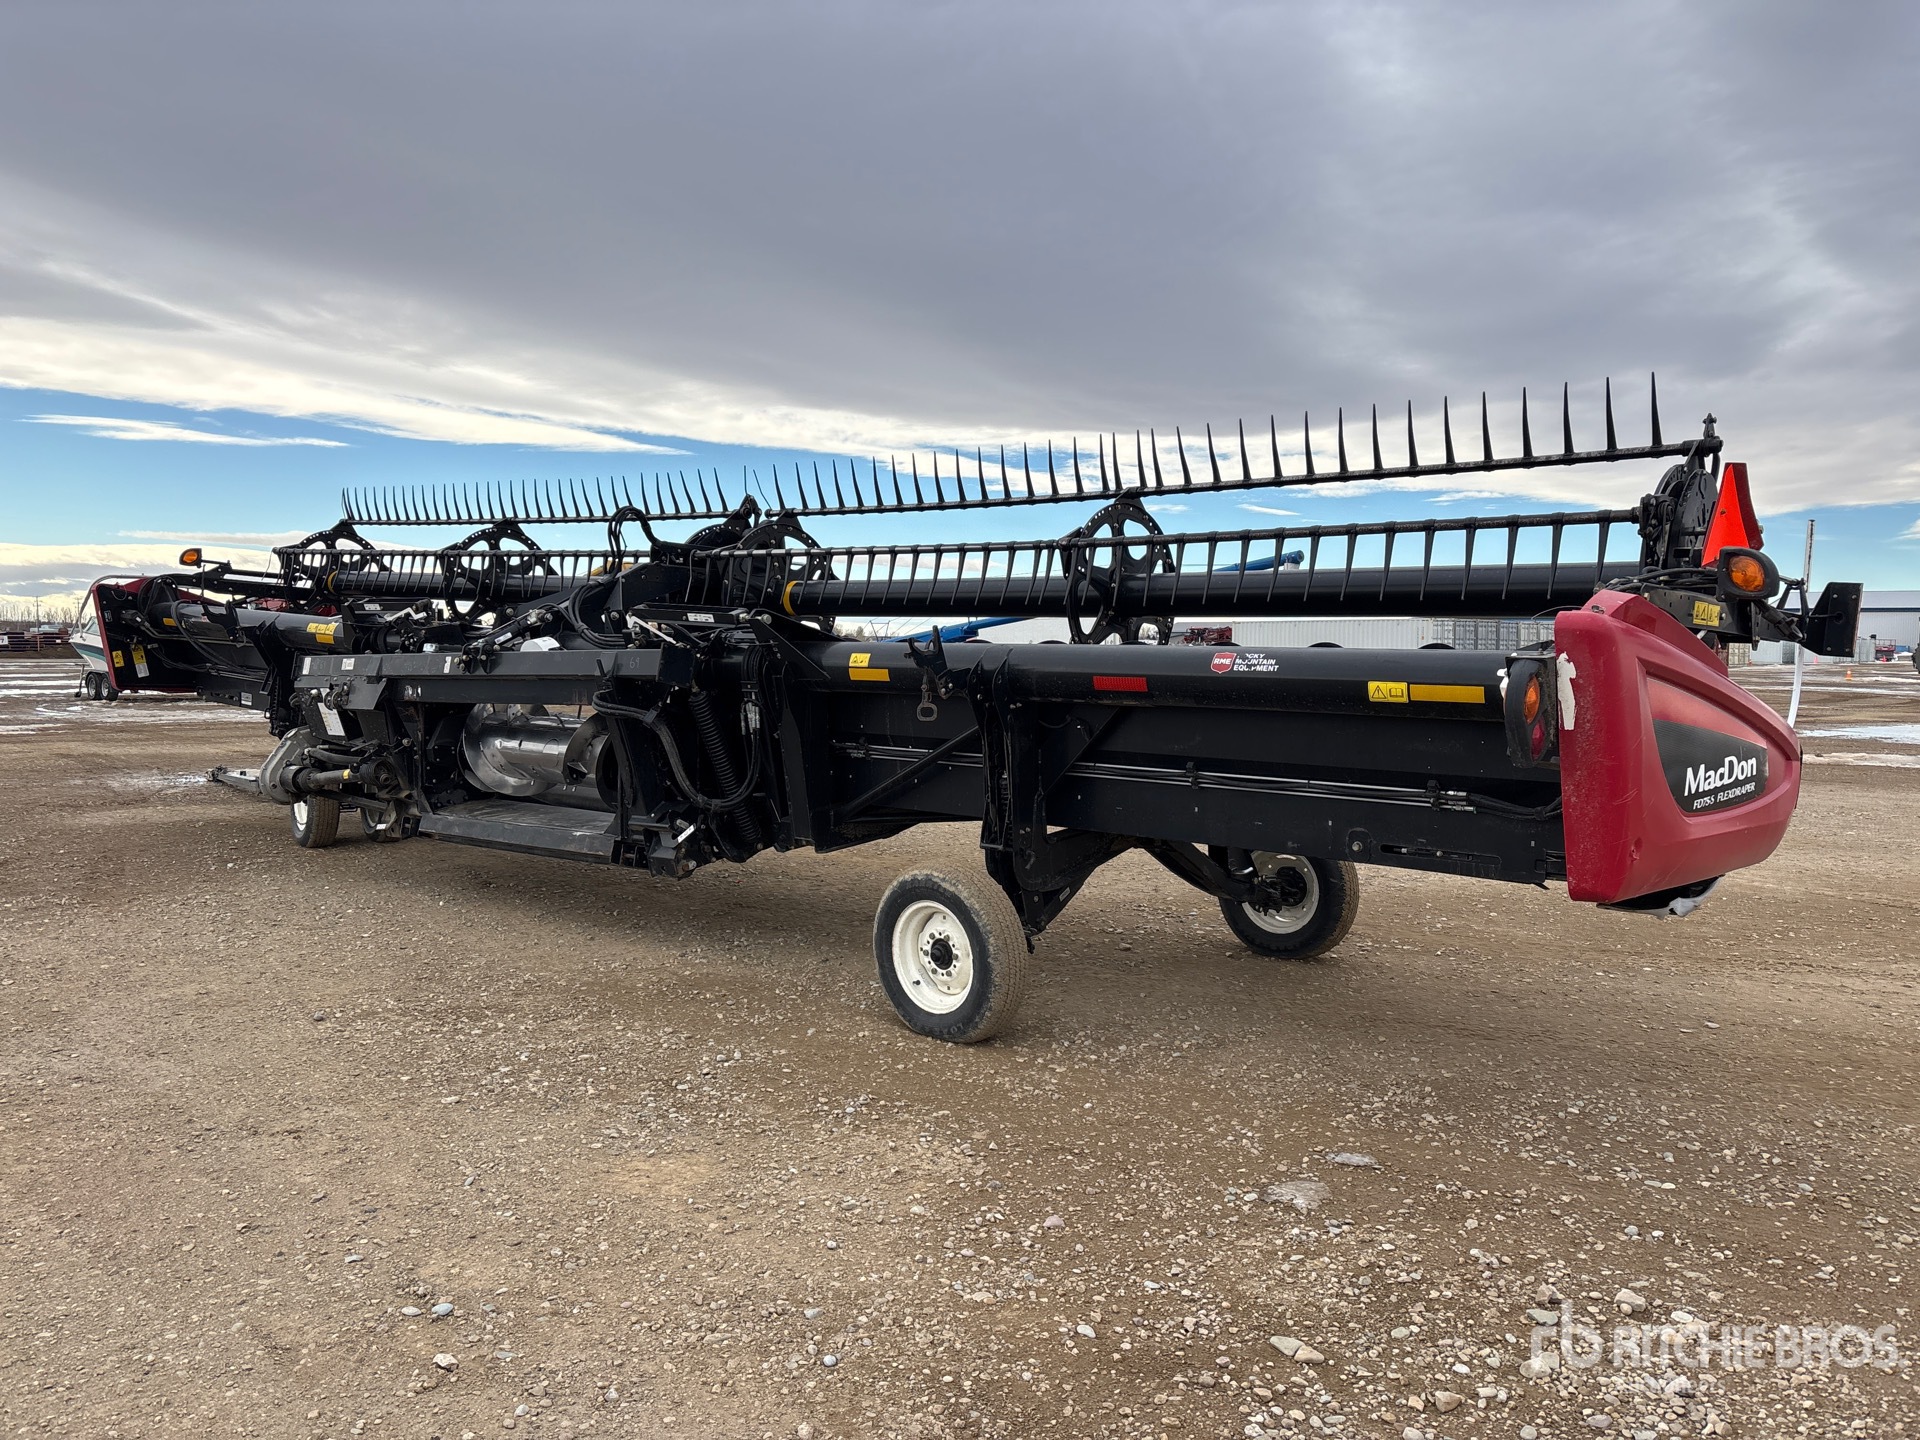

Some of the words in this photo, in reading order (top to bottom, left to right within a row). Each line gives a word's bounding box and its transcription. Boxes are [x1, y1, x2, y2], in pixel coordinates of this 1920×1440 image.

[1233, 664, 1279, 672] EQUPMENT
[1684, 755, 1757, 797] MacDon
[1716, 782, 1756, 803] FLEXDRAPER
